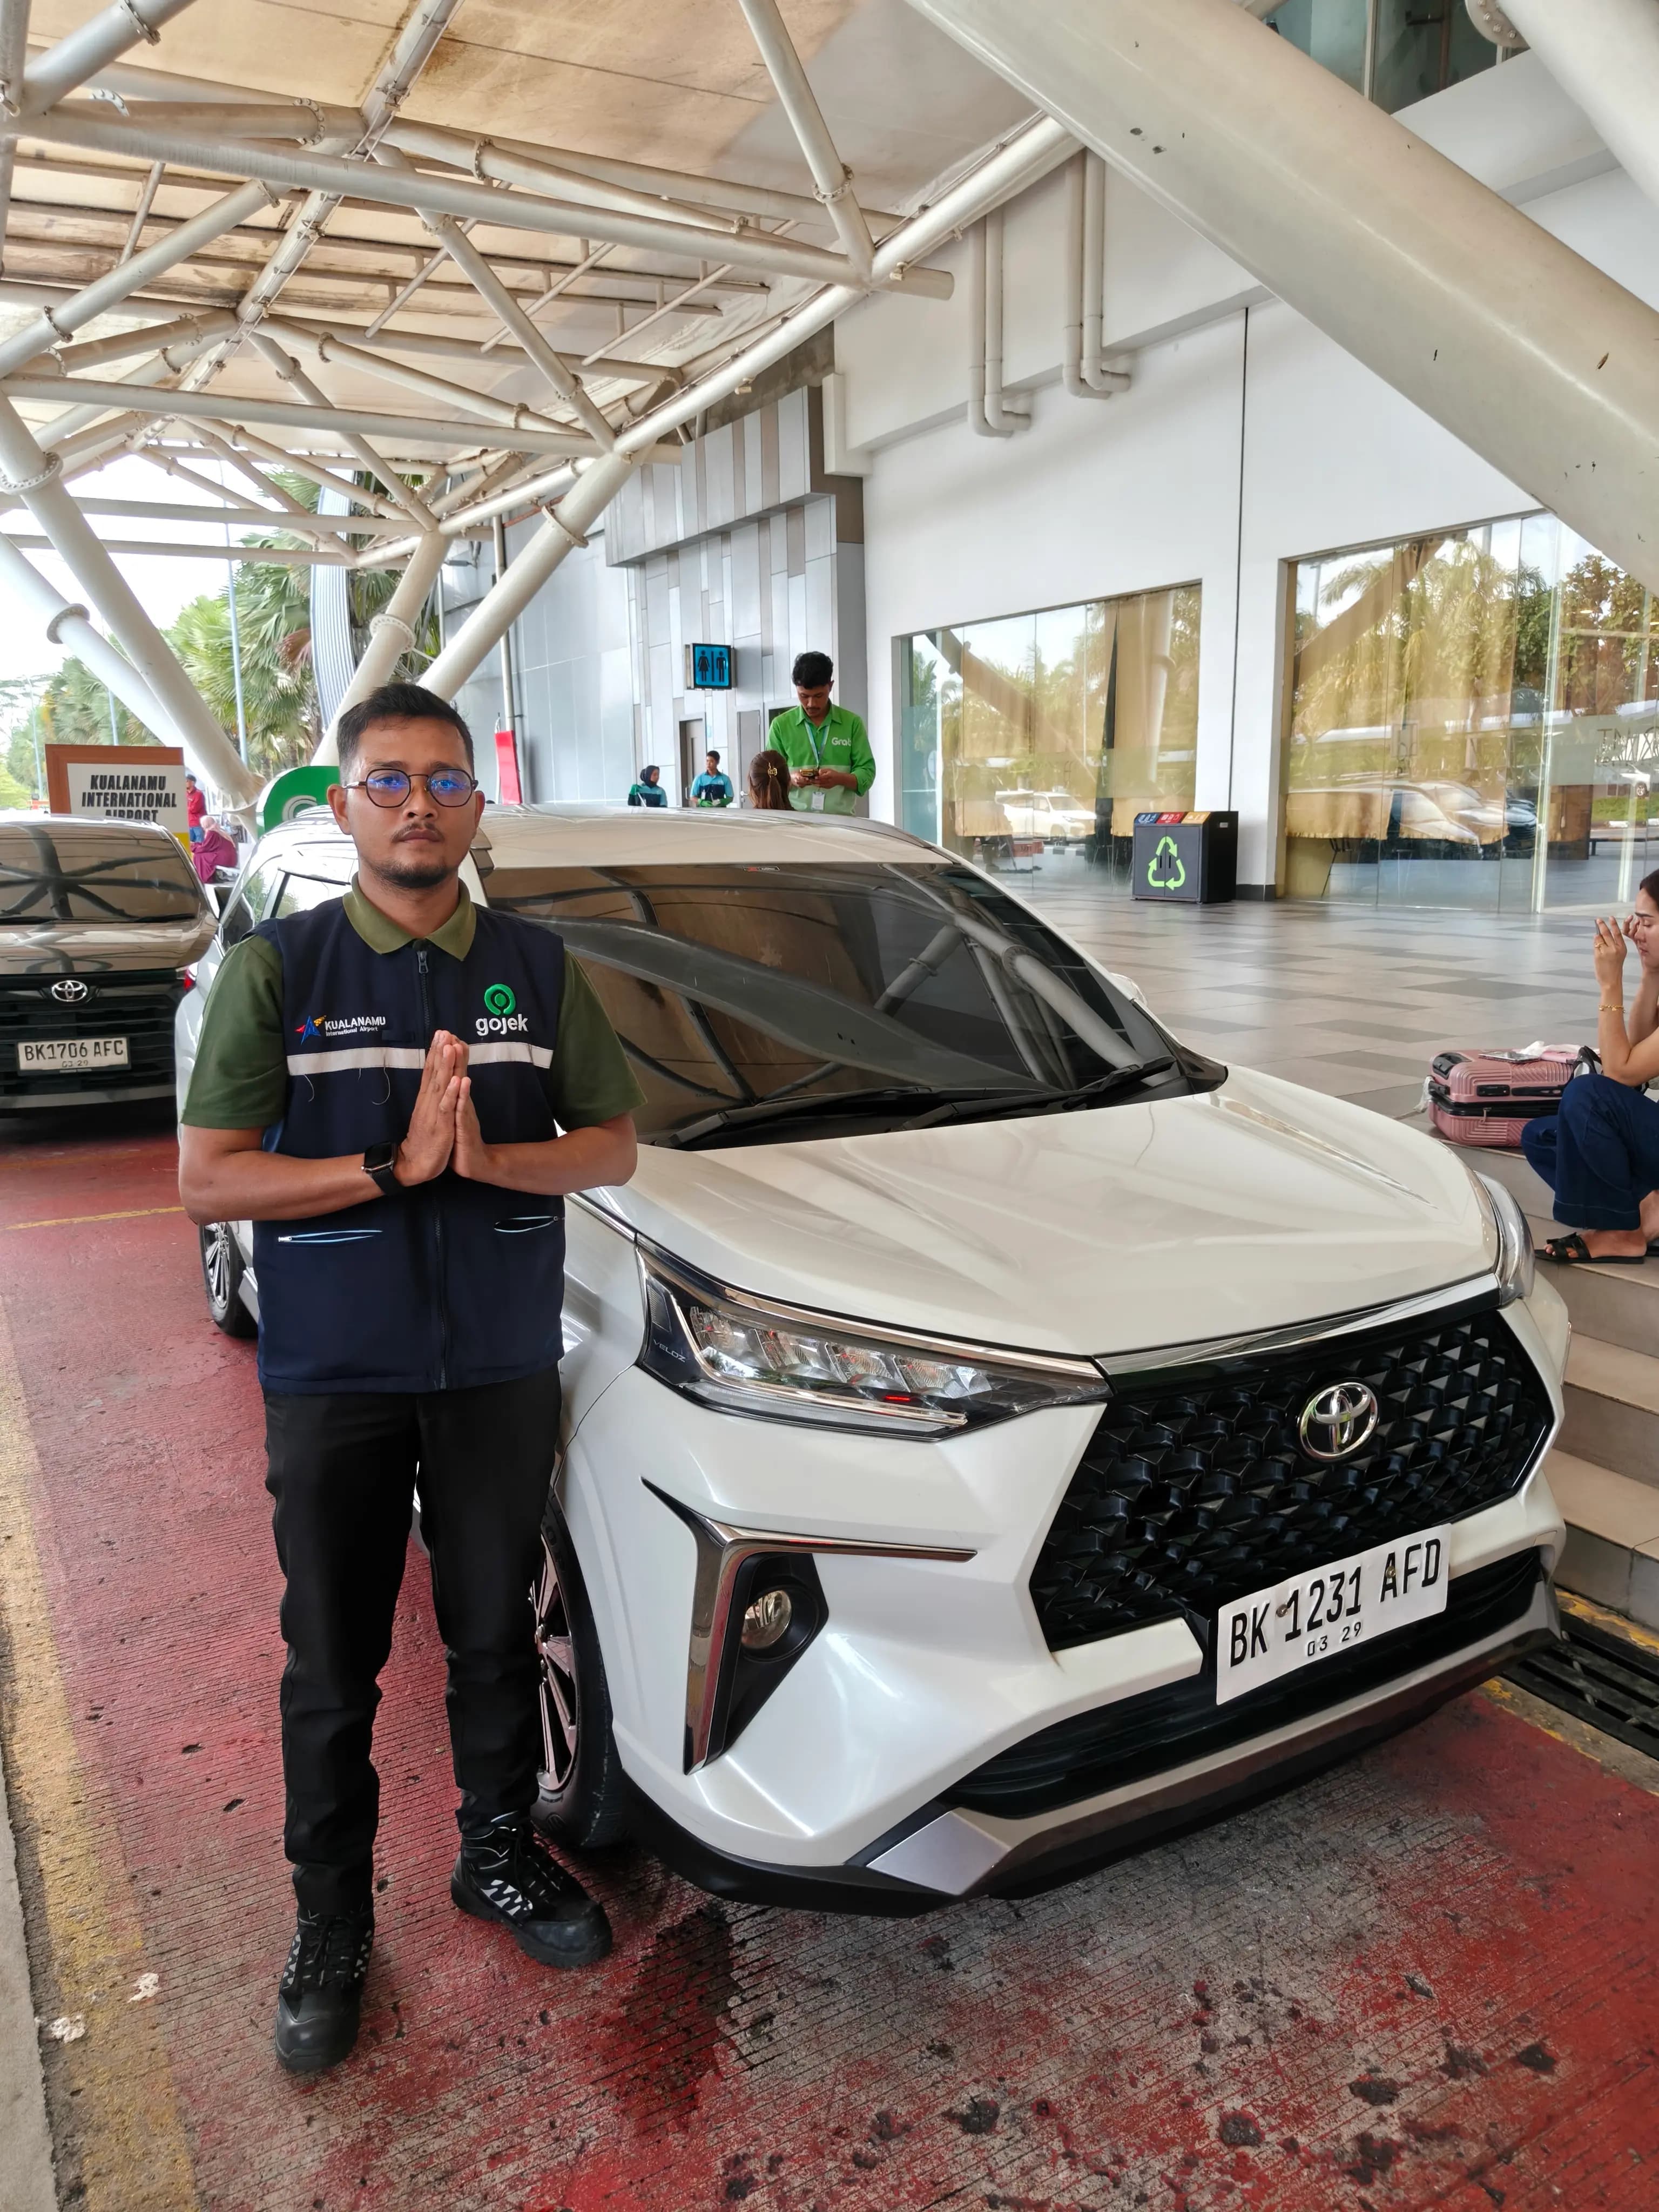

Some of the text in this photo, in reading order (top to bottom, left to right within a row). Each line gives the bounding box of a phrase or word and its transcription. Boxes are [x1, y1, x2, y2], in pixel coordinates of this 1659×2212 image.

[90, 774, 166, 791] KUALANAMU
[82, 792, 177, 808] INTERNATIONAL
[325, 1016, 386, 1031] KUALANAMU
[326, 1027, 357, 1037] International
[476, 1014, 529, 1036] gojek
[93, 1040, 124, 1057] AFC
[653, 1339, 686, 1363] VELOZ
[1230, 1538, 1441, 1668] BK 1231 AFD
[1307, 1622, 1361, 1656] 03 29
